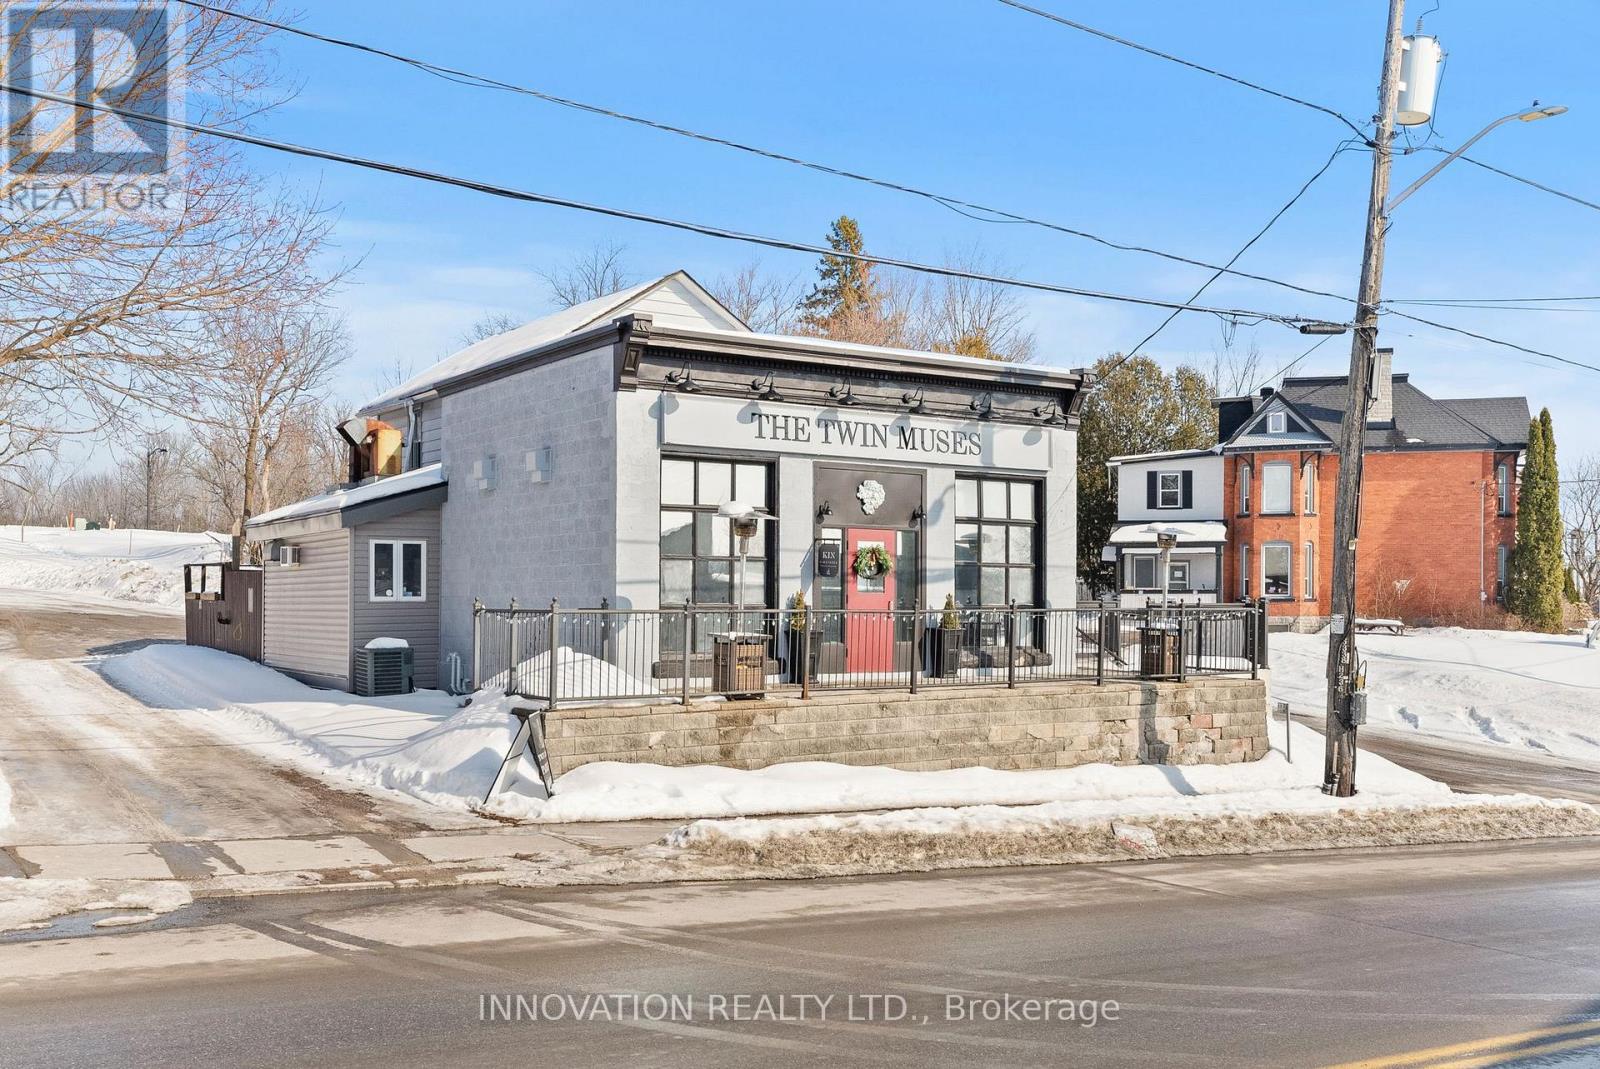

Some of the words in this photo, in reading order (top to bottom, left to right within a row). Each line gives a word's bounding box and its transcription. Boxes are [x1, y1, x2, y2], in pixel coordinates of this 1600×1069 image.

[750, 412, 811, 443] THE
[817, 419, 888, 449] TWIN
[896, 425, 982, 456] MUSES
